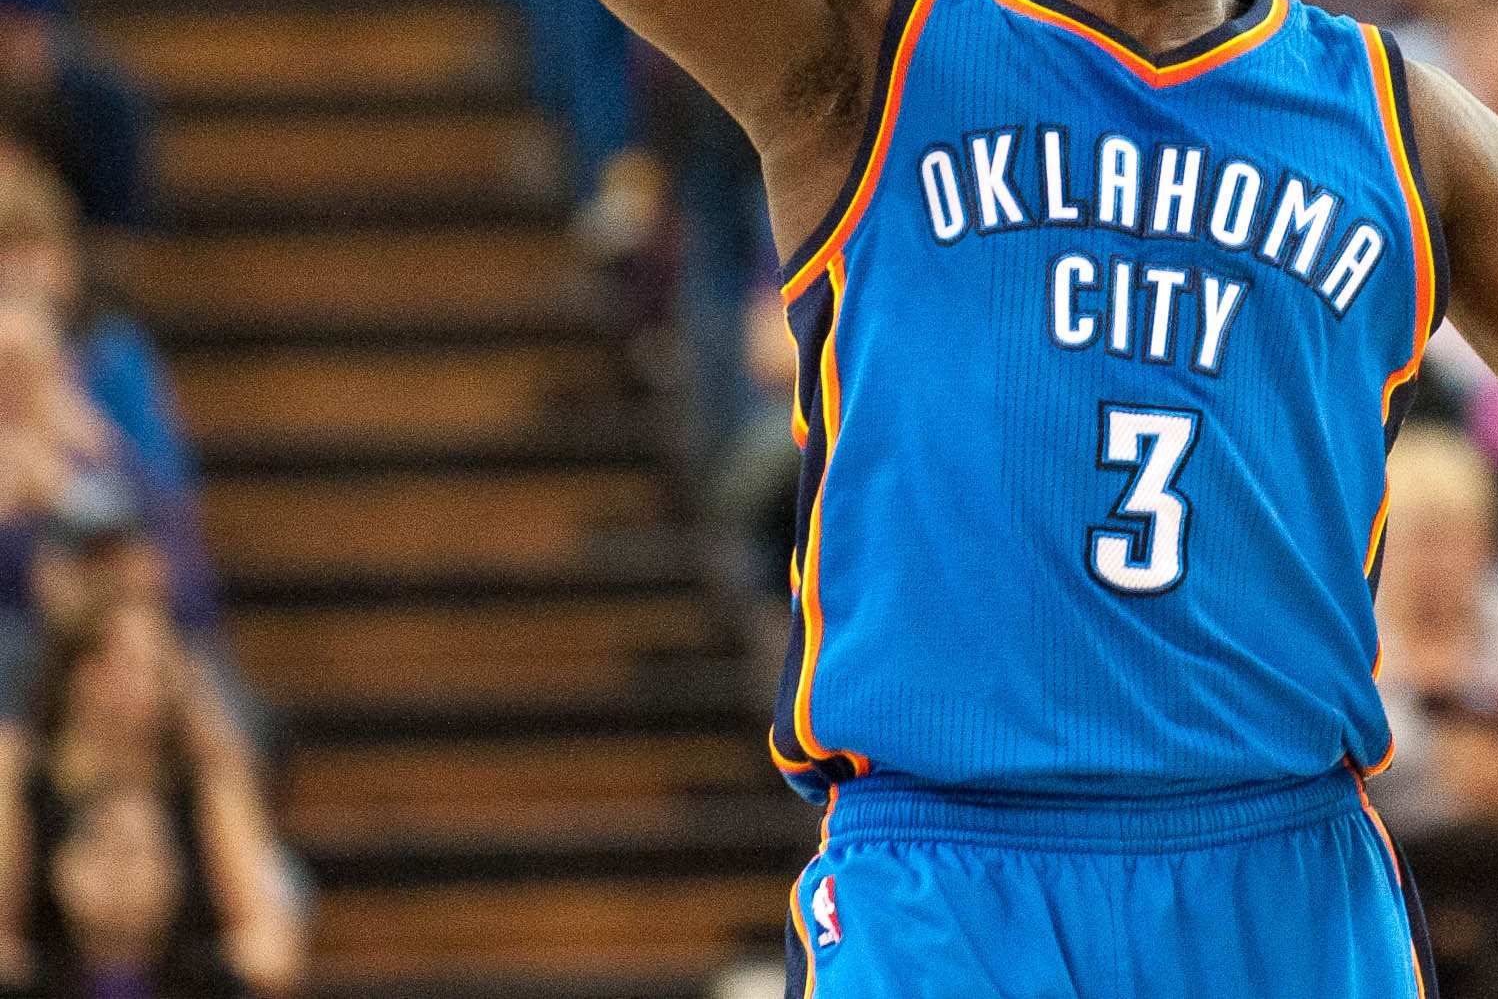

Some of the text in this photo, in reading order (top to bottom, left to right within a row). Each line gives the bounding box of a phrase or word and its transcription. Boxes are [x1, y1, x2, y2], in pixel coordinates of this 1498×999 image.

[917, 124, 1388, 320] OKLAHOMA
[1047, 249, 1251, 376] CITY
[1086, 400, 1202, 597] 3
